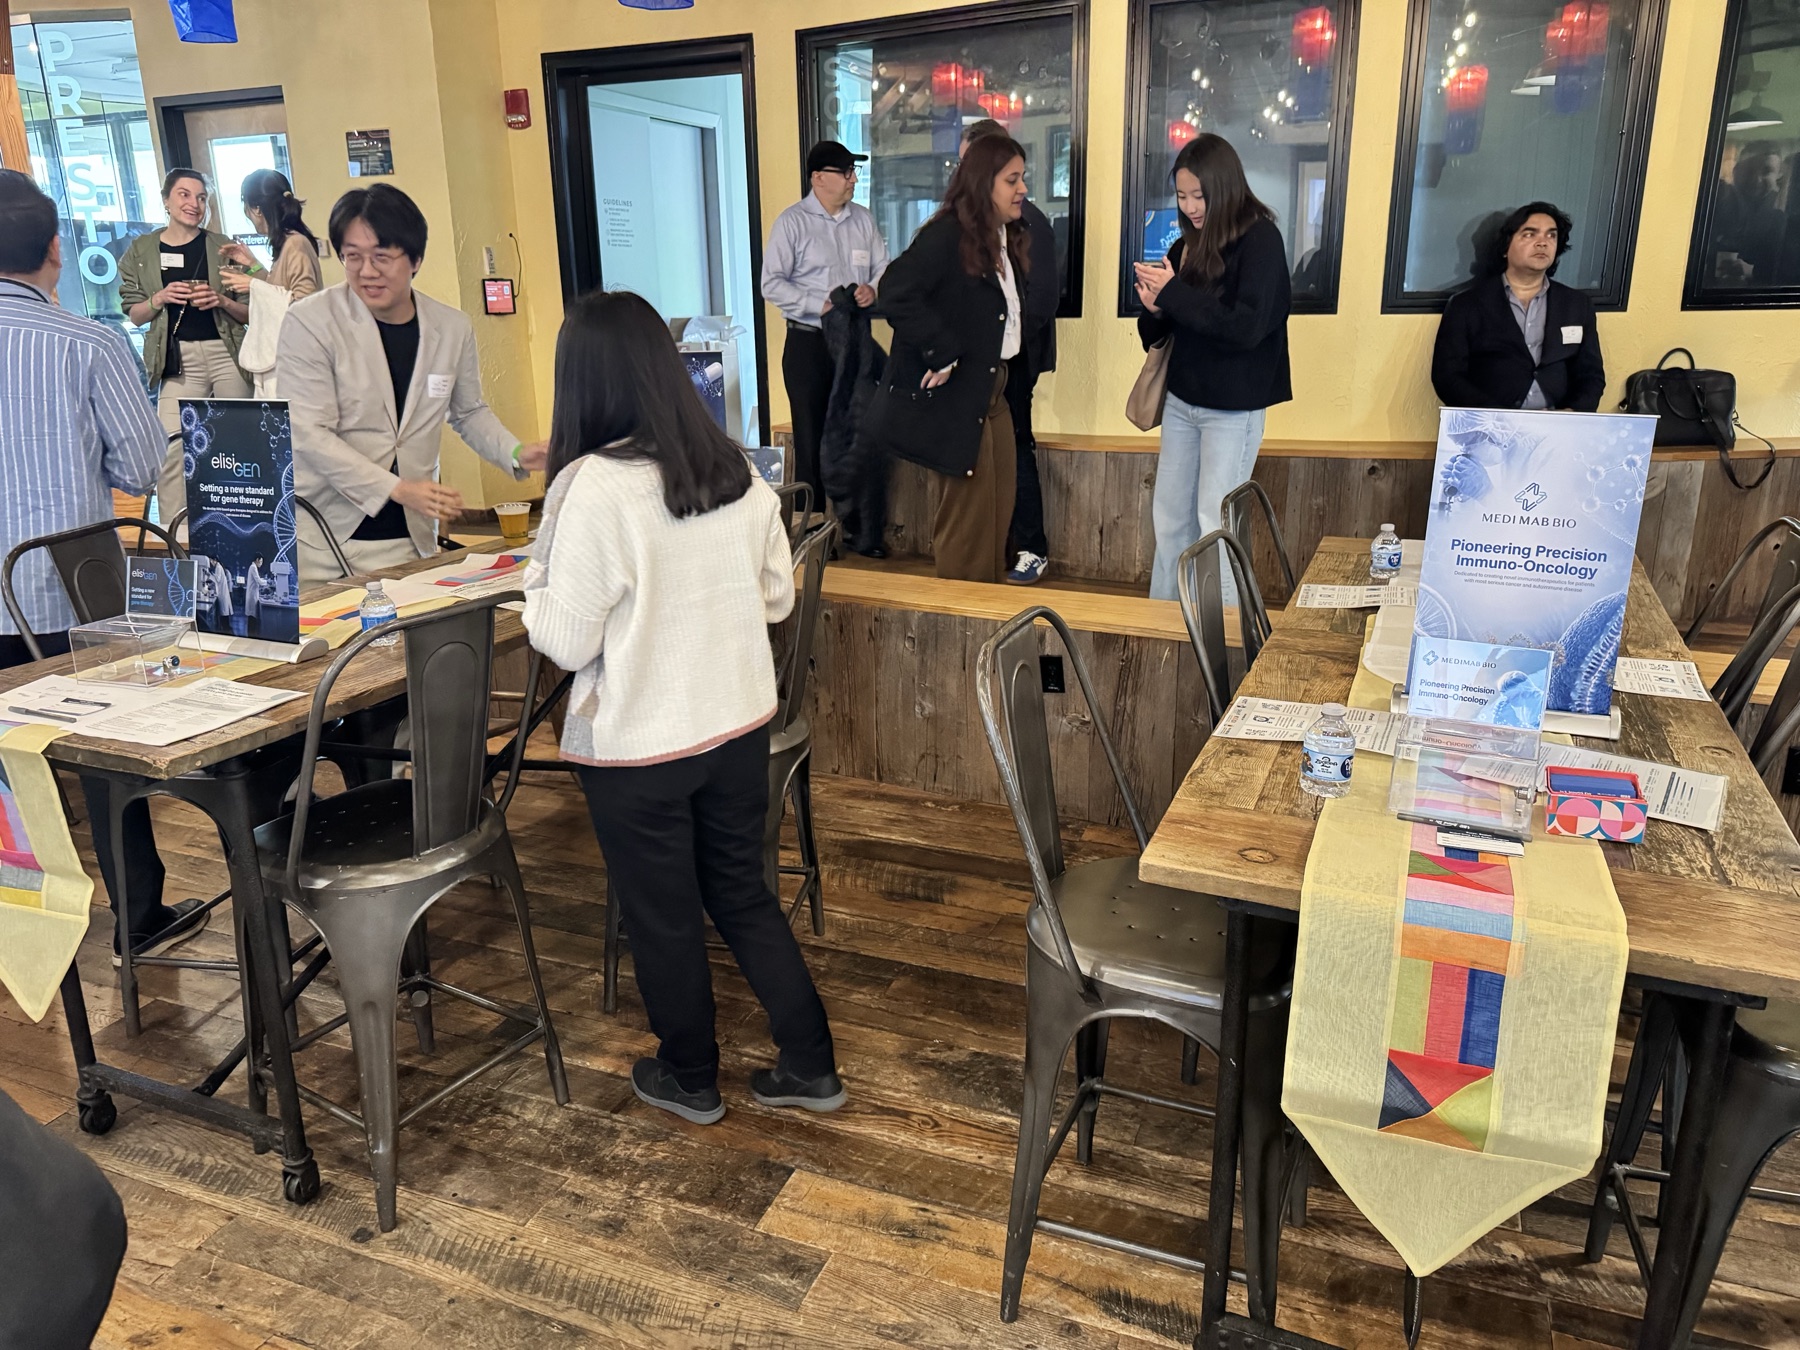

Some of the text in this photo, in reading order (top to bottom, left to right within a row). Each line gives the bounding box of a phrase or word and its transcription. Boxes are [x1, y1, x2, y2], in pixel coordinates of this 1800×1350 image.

[39, 31, 118, 285] PRESTO
[603, 198, 633, 207] GUIDELINES
[199, 483, 224, 495] Setting
[230, 486, 244, 494] new
[245, 486, 275, 496] standard
[210, 493, 264, 507] for gene therapy
[1450, 539, 1608, 563] Pioneering Precision
[1455, 554, 1598, 580] Immuno-Oncology
[1419, 679, 1496, 695] Pioneering Precision
[1418, 689, 1489, 706] Immuno-Oncology
